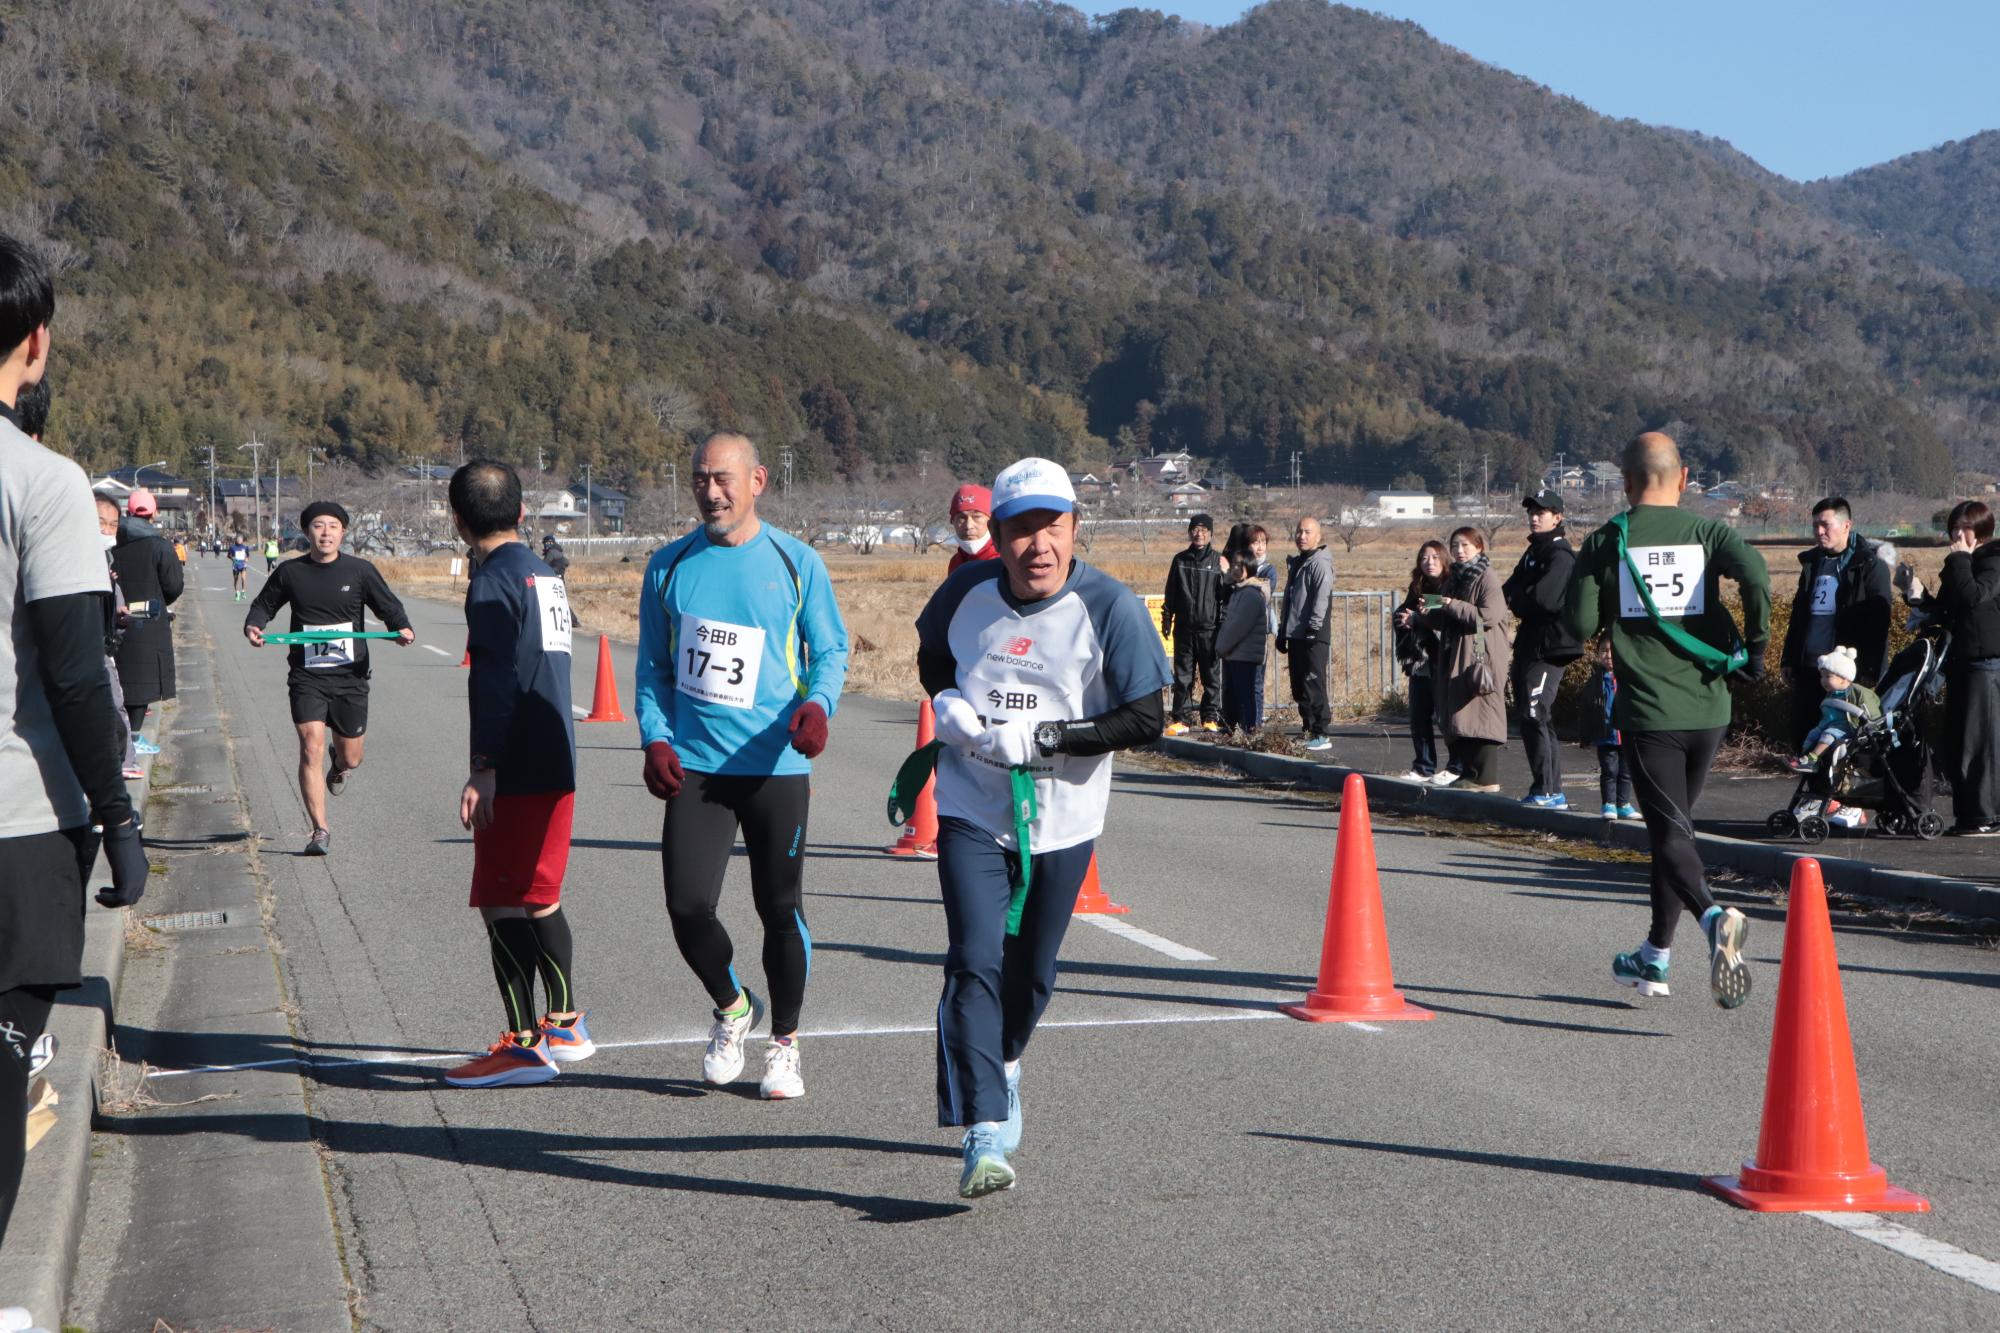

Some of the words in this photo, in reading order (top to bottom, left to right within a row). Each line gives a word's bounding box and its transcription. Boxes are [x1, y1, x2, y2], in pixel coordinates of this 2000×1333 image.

[1648, 551, 1676, 566] 日置
[696, 625, 738, 646] 今田B
[312, 639, 347, 656] 12-4
[687, 647, 745, 686] 17-3
[1006, 655, 1044, 671] balance
[987, 689, 1038, 710] 今田B
